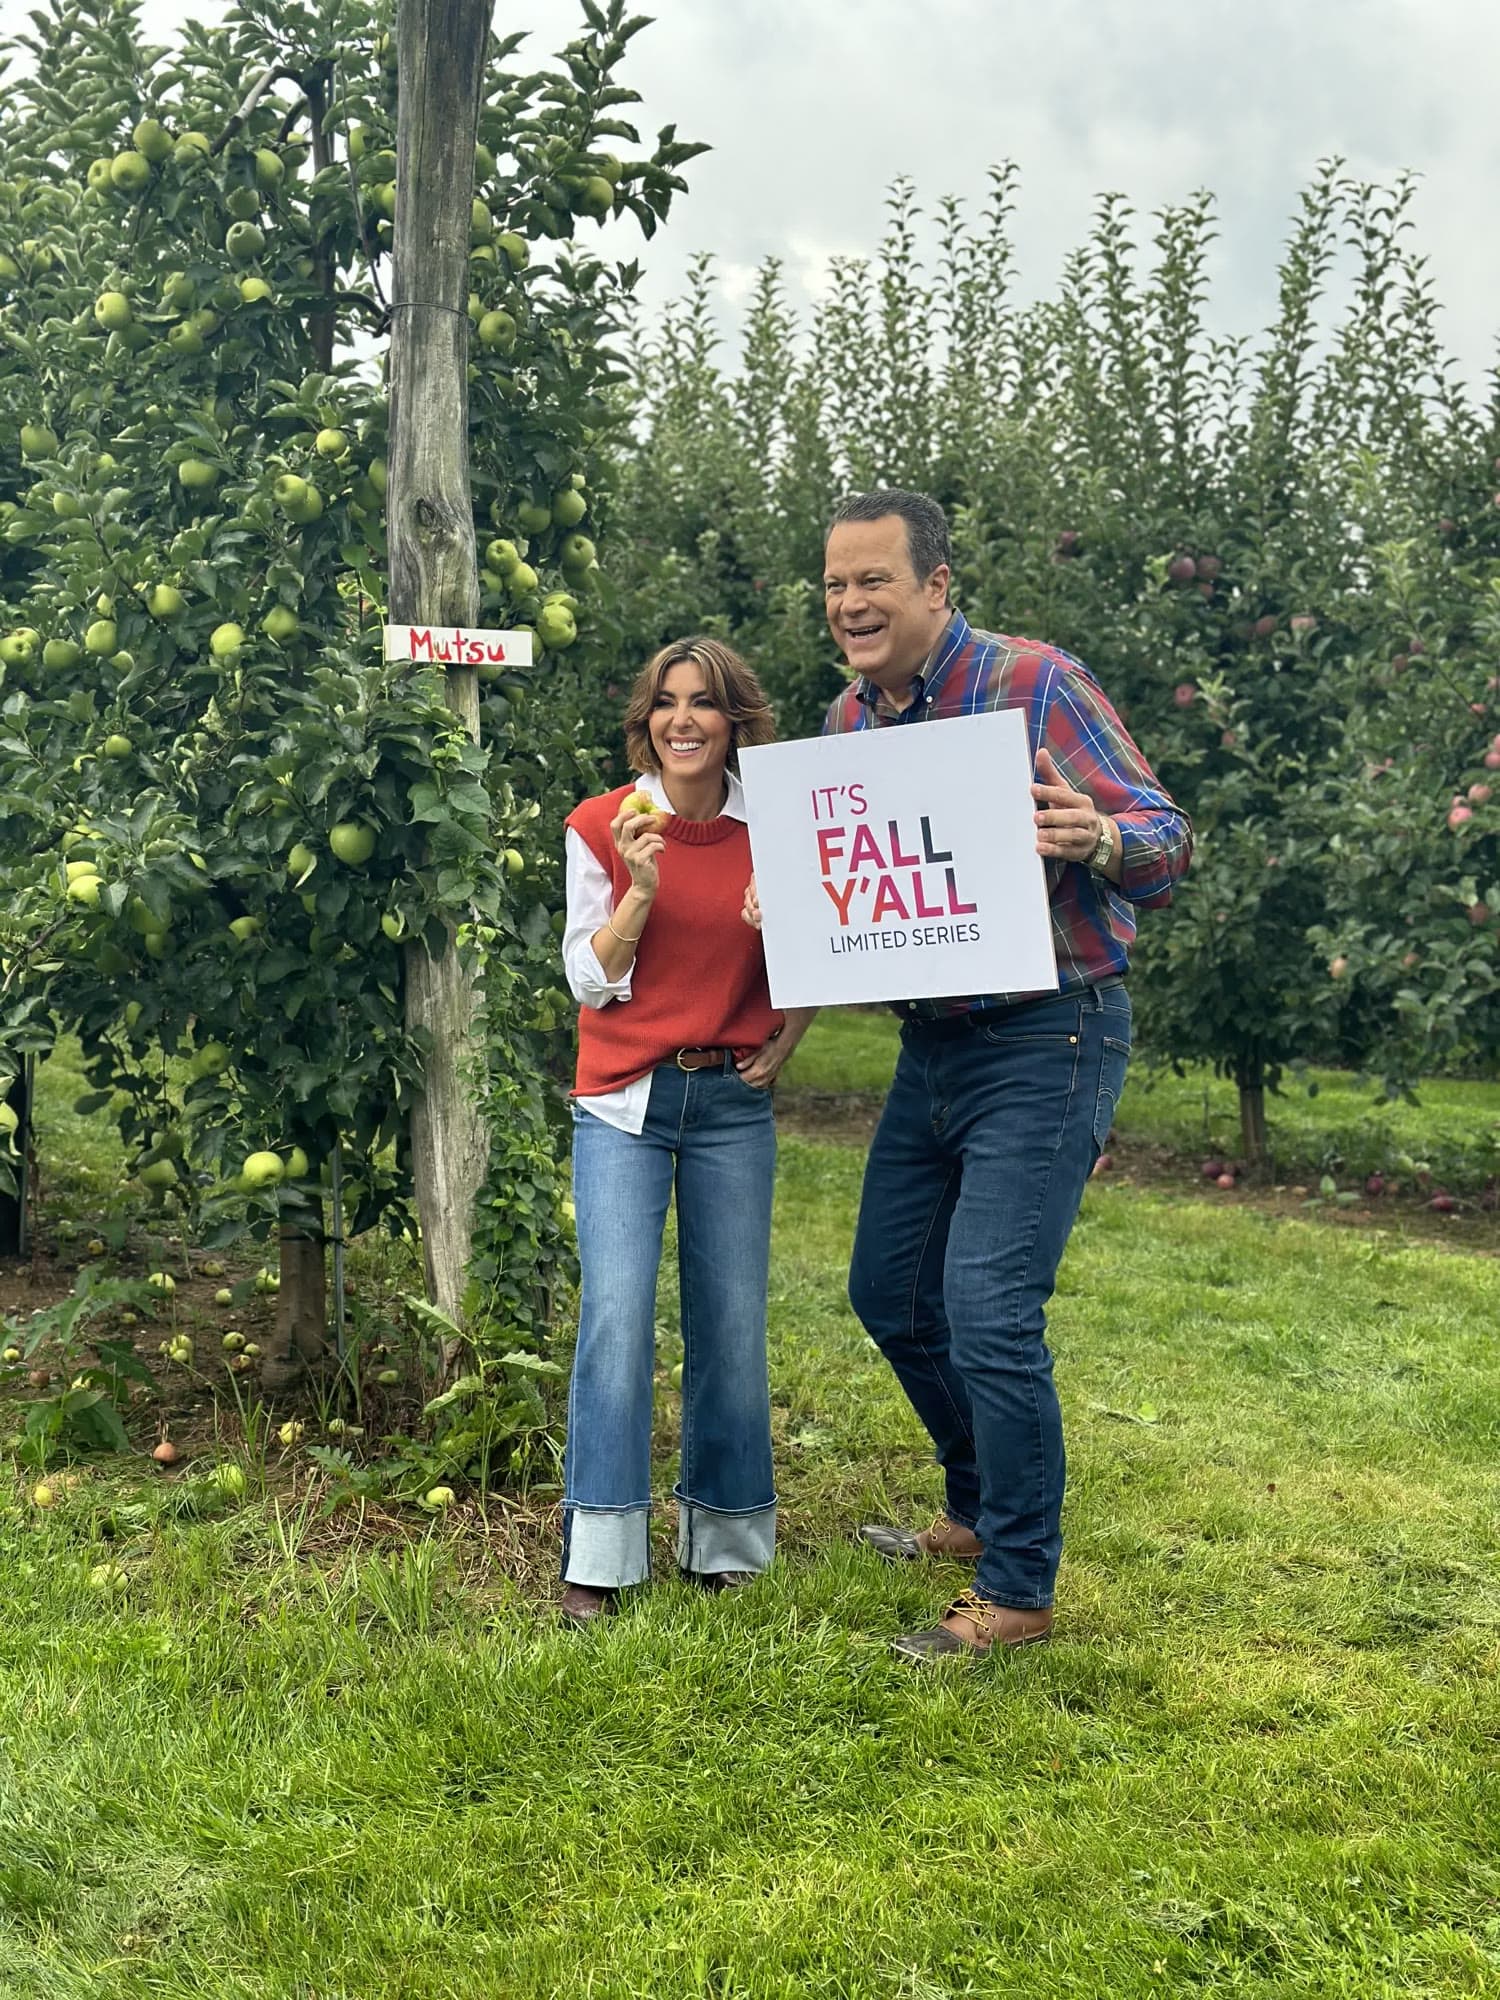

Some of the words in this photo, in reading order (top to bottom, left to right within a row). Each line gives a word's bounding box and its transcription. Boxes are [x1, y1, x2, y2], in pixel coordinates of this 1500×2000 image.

[410, 628, 505, 664] Mutsu
[811, 784, 868, 820] IT'S
[816, 816, 953, 876] FALL
[821, 868, 978, 926] Y'ALL
[830, 930, 907, 954] LIMITED
[912, 923, 981, 947] SERIES
